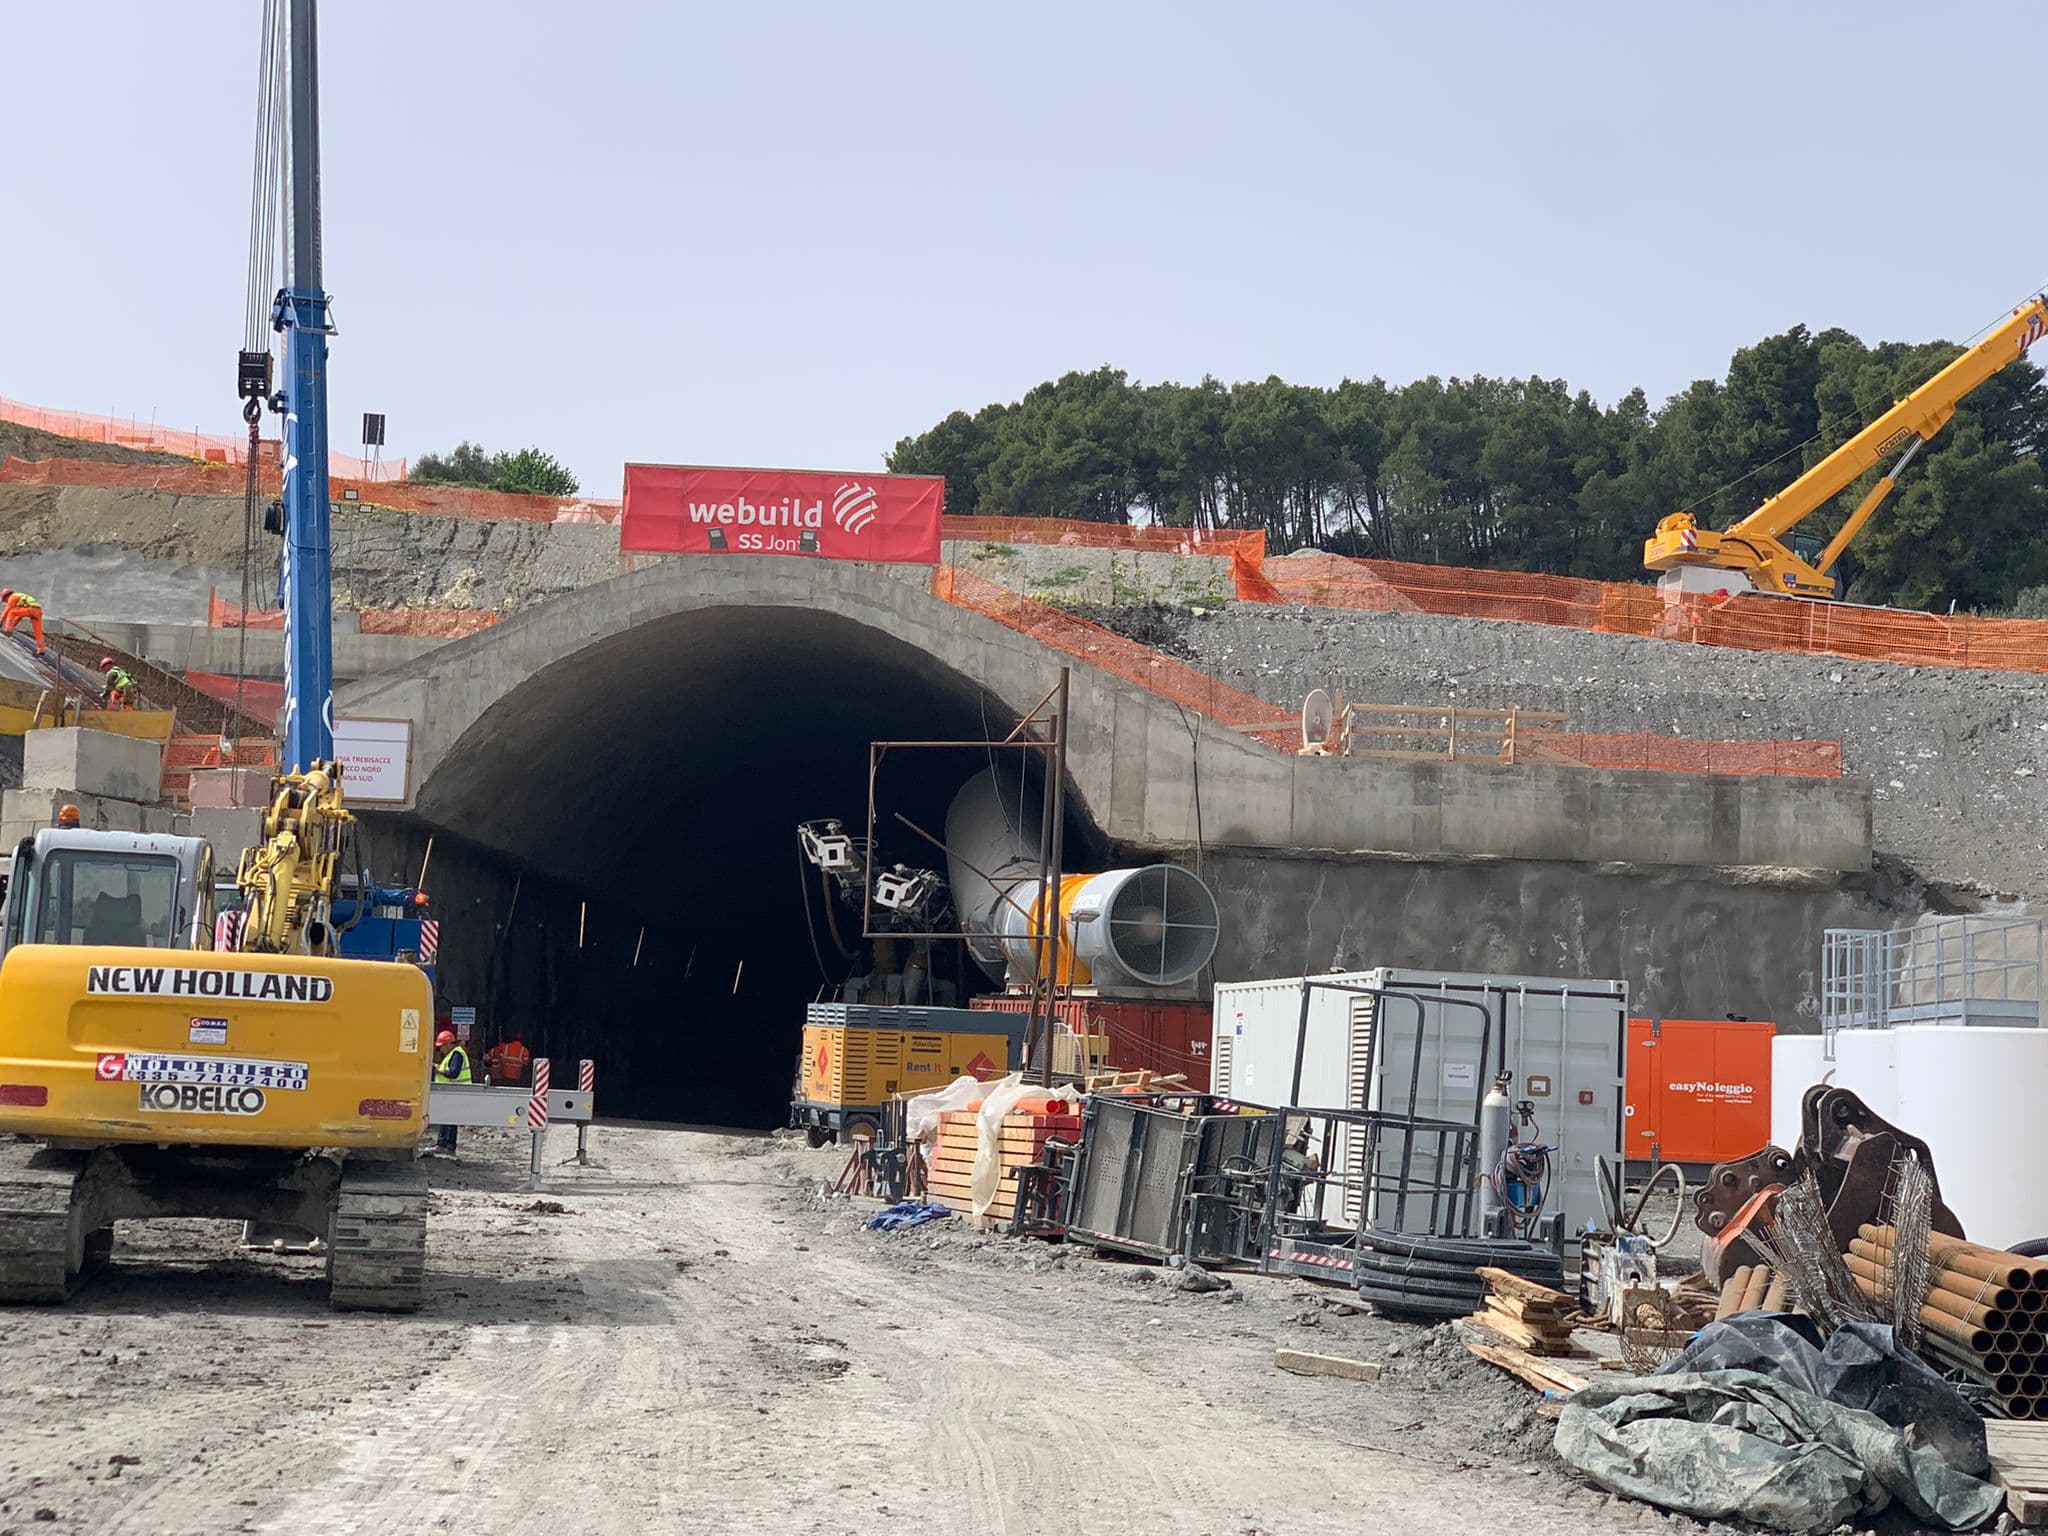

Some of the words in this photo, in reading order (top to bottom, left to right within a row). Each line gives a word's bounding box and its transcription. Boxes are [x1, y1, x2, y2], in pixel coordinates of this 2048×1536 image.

[688, 496, 823, 528] webuild
[738, 533, 763, 549] SS
[88, 967, 165, 993] NEW
[173, 969, 333, 1002] HOLLAND
[125, 1058, 305, 1079] NOLOGRIECO
[906, 1062, 931, 1072] Rent
[136, 1071, 303, 1089] 335-7442400
[140, 1083, 265, 1113] KOBELCO
